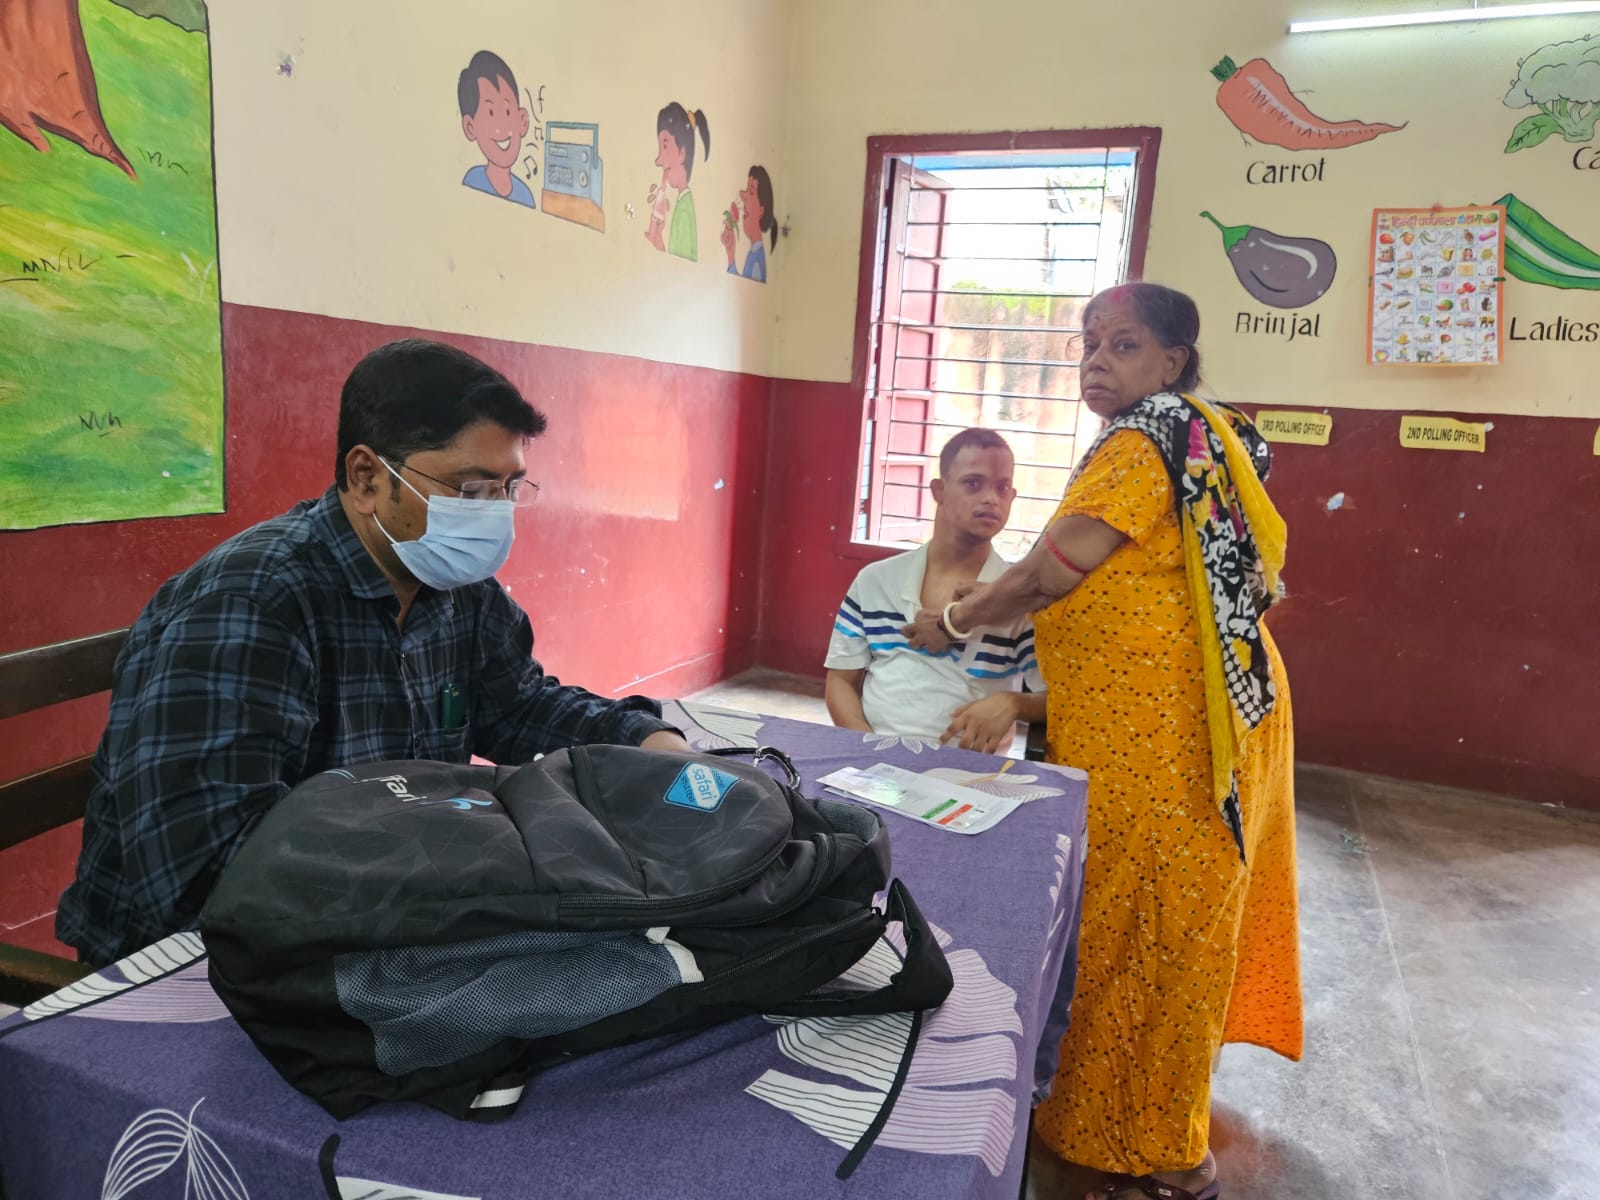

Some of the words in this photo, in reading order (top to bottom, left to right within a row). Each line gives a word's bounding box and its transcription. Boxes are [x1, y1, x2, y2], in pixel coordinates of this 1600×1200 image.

[1246, 156, 1326, 185] Carrot
[1234, 311, 1321, 342] Brinjal
[1509, 315, 1600, 342] Ladies
[1261, 419, 1275, 432] 3RD
[1275, 420, 1302, 435] POLLING
[1302, 422, 1327, 437] OFFICER
[1407, 426, 1422, 440] 2ND
[1422, 427, 1453, 442] POLLING
[1453, 428, 1480, 445] OFFICER
[692, 767, 718, 801] safari
